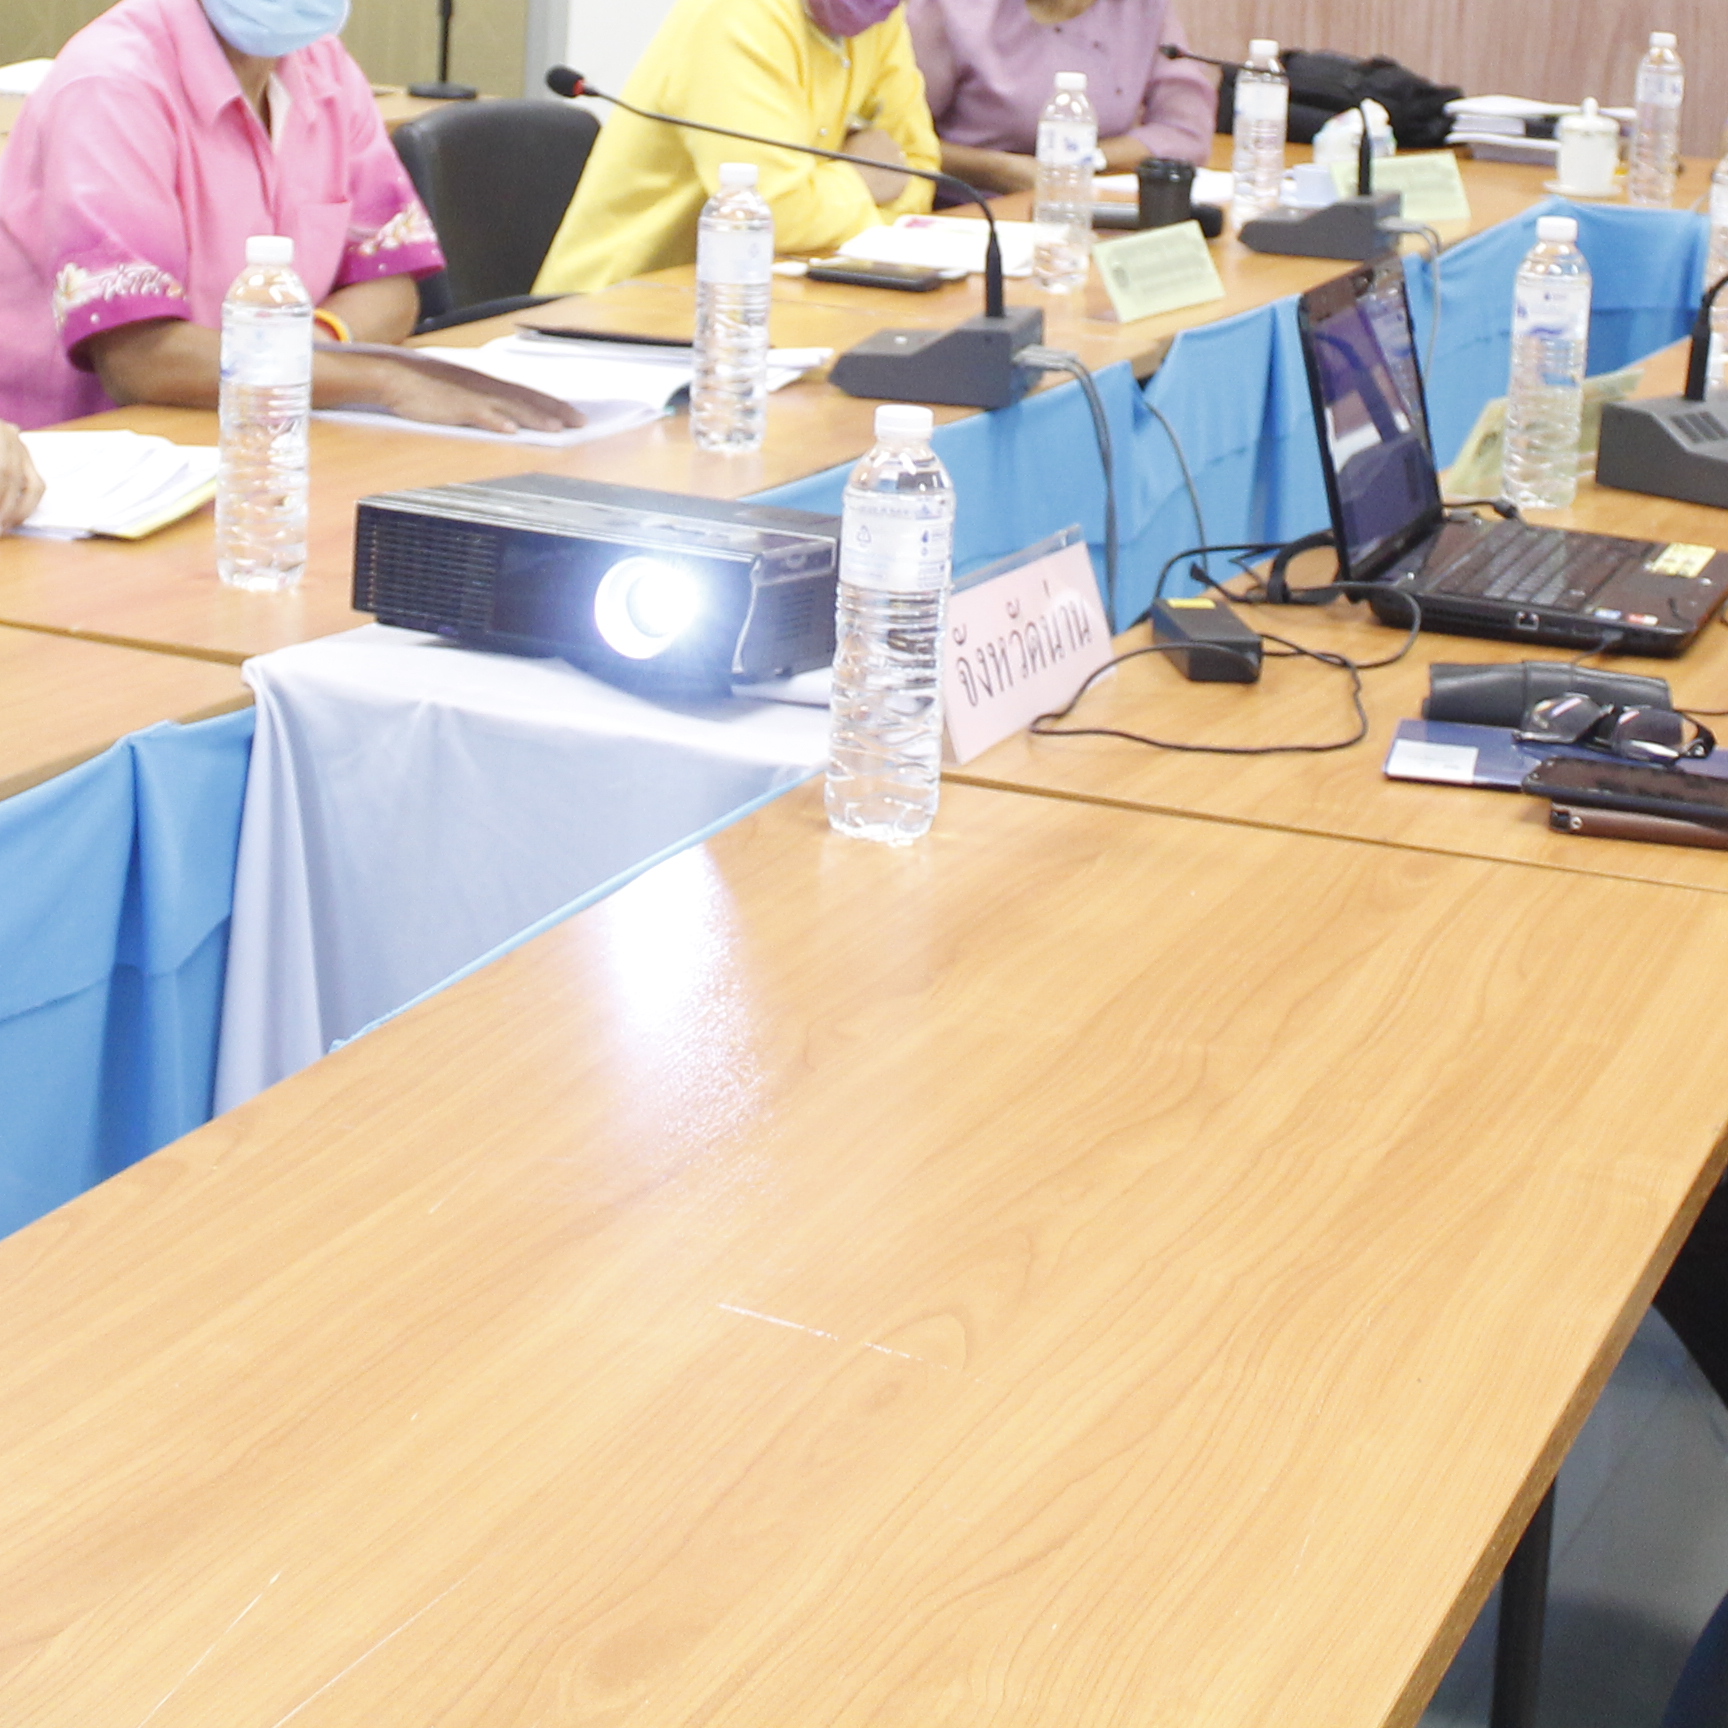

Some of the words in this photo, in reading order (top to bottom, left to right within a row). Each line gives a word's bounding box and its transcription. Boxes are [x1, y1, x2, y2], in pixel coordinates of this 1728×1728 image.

[952, 578, 1092, 707] จังหวัดน่าน
